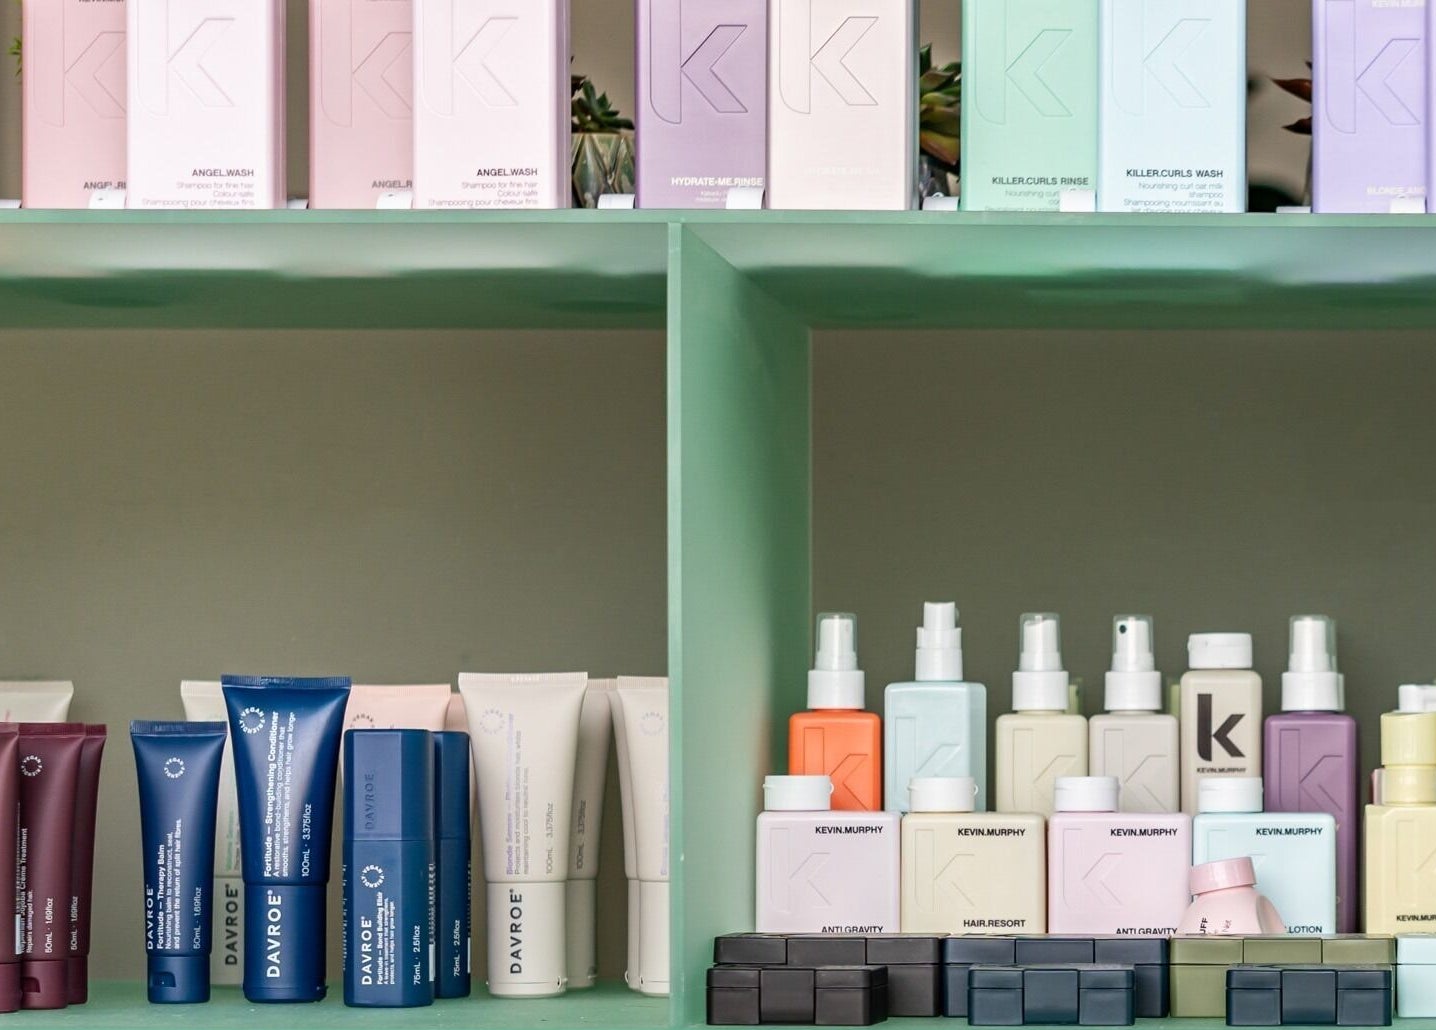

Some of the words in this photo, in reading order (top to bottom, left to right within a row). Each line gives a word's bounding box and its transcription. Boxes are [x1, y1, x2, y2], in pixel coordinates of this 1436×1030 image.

[192, 168, 255, 177] ANGEL.WASH
[477, 168, 538, 177] ANGEL.WASH
[1126, 169, 1193, 178] KILLER.CURLS
[1196, 169, 1223, 178] WASH
[671, 176, 764, 186] HYDRATE-ME.RINSE
[992, 177, 1057, 186] KILLER.CURLS
[1060, 177, 1089, 186] RINSE
[268, 711, 279, 761] Conditioner
[265, 763, 277, 825] Strengthening
[302, 804, 311, 840] 3.375floz
[815, 825, 884, 835] KEVIN.MURPHY
[957, 827, 1026, 837] KEVIN.MURPHY
[1110, 827, 1178, 837] KEVIN.MURPHY
[1256, 827, 1323, 837] KEVIN.MURPHY
[157, 844, 165, 865] Balm
[264, 836, 273, 877] Fortitude
[302, 849, 310, 877] 100mL
[157, 866, 166, 900] Therapy
[963, 919, 1026, 928] HAIR.RESORT
[193, 925, 201, 950] 50mL
